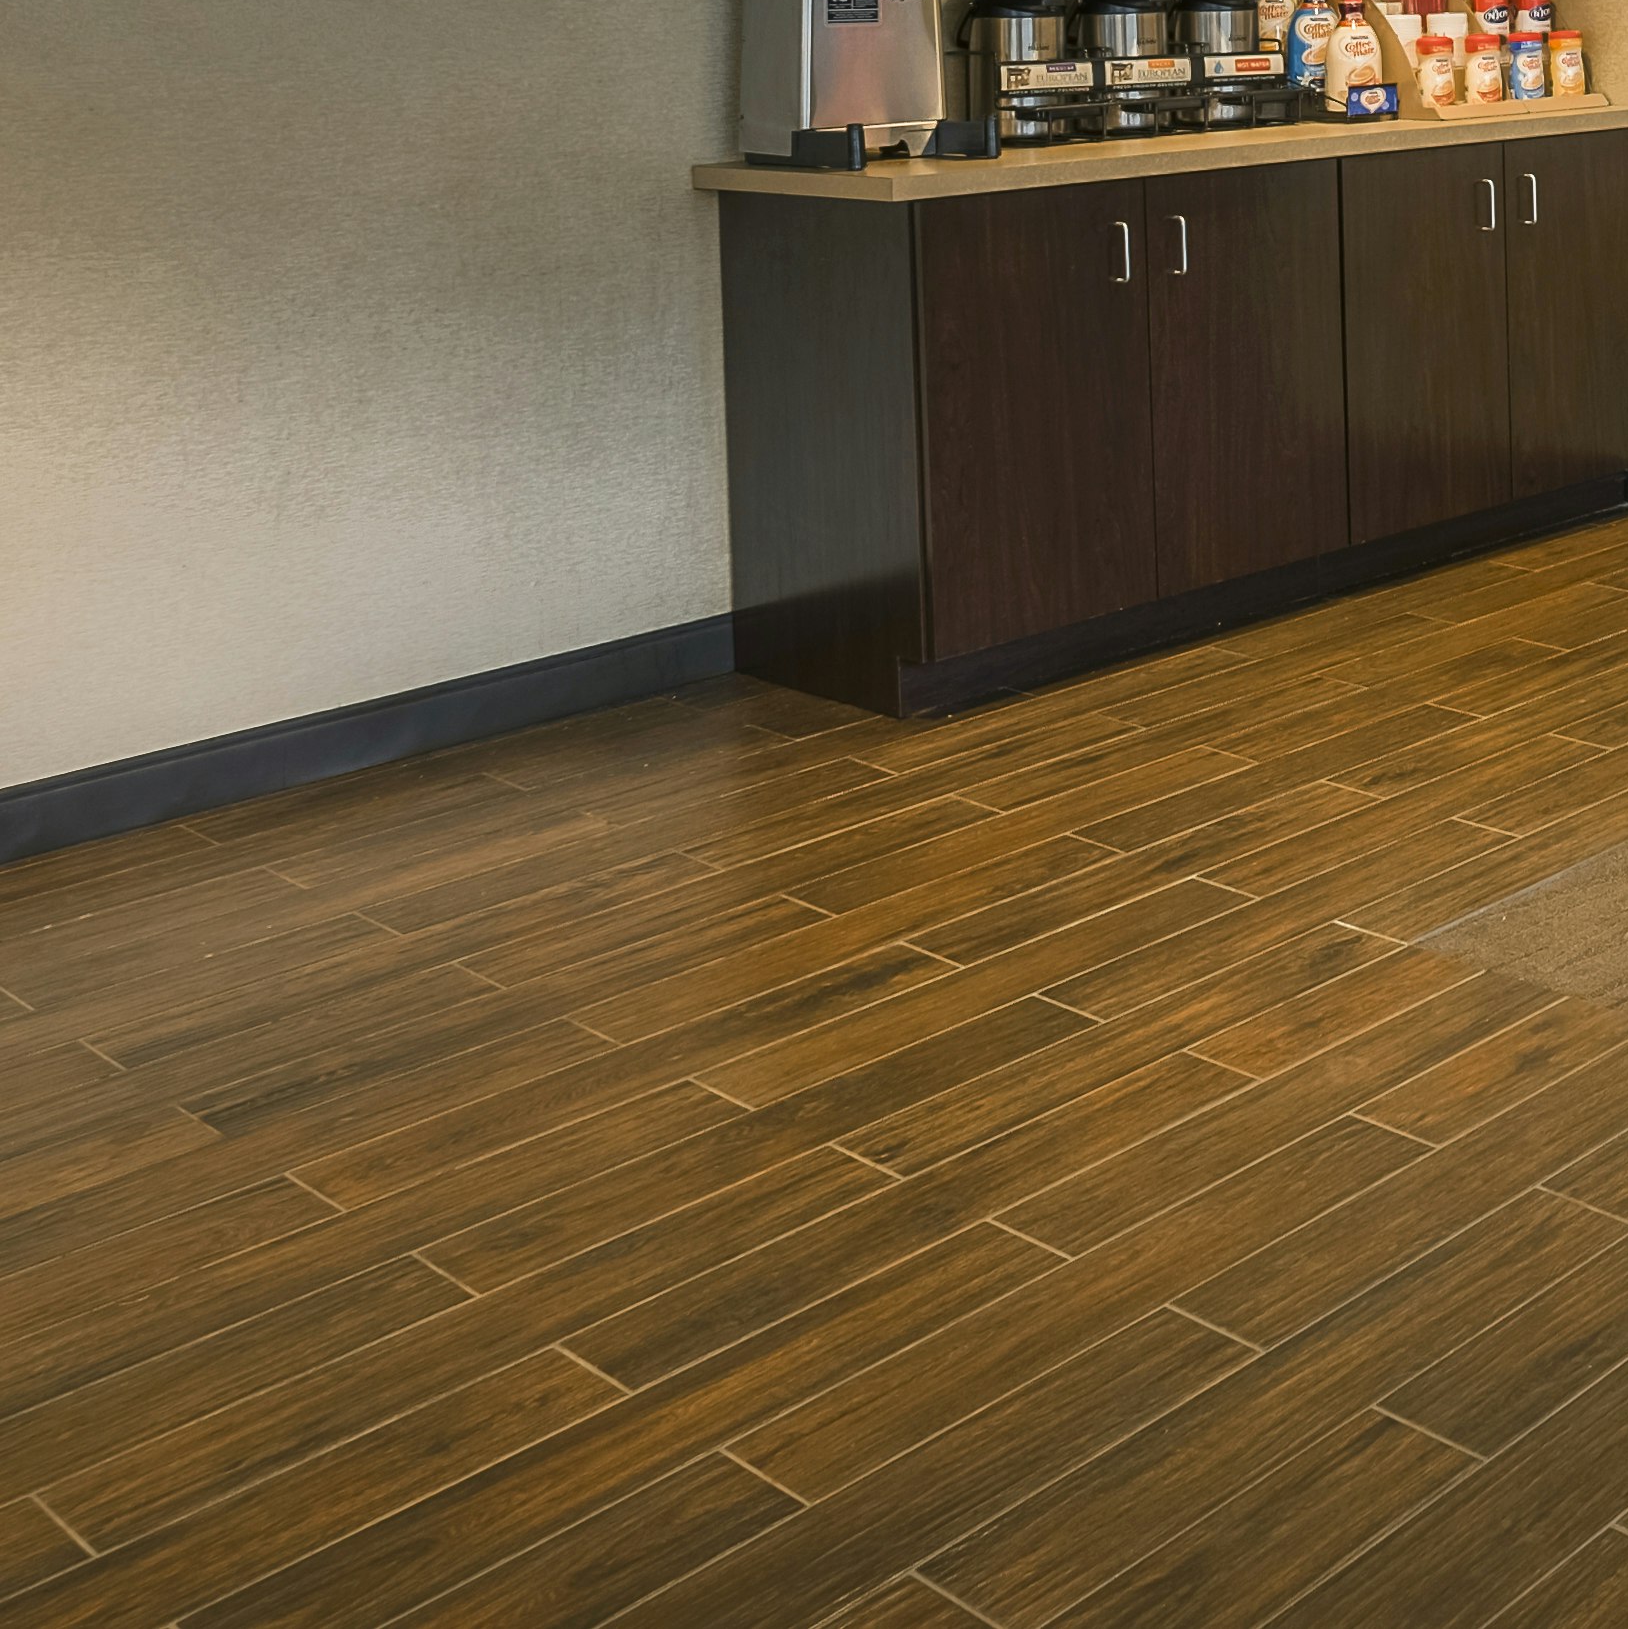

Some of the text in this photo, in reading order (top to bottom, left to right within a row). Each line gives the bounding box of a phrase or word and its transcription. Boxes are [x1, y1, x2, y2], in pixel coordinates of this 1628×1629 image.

[1259, 3, 1287, 15] Coffee
[1304, 23, 1332, 34] Coffee
[1345, 41, 1372, 53] Coffee
[1353, 47, 1375, 57] mate
